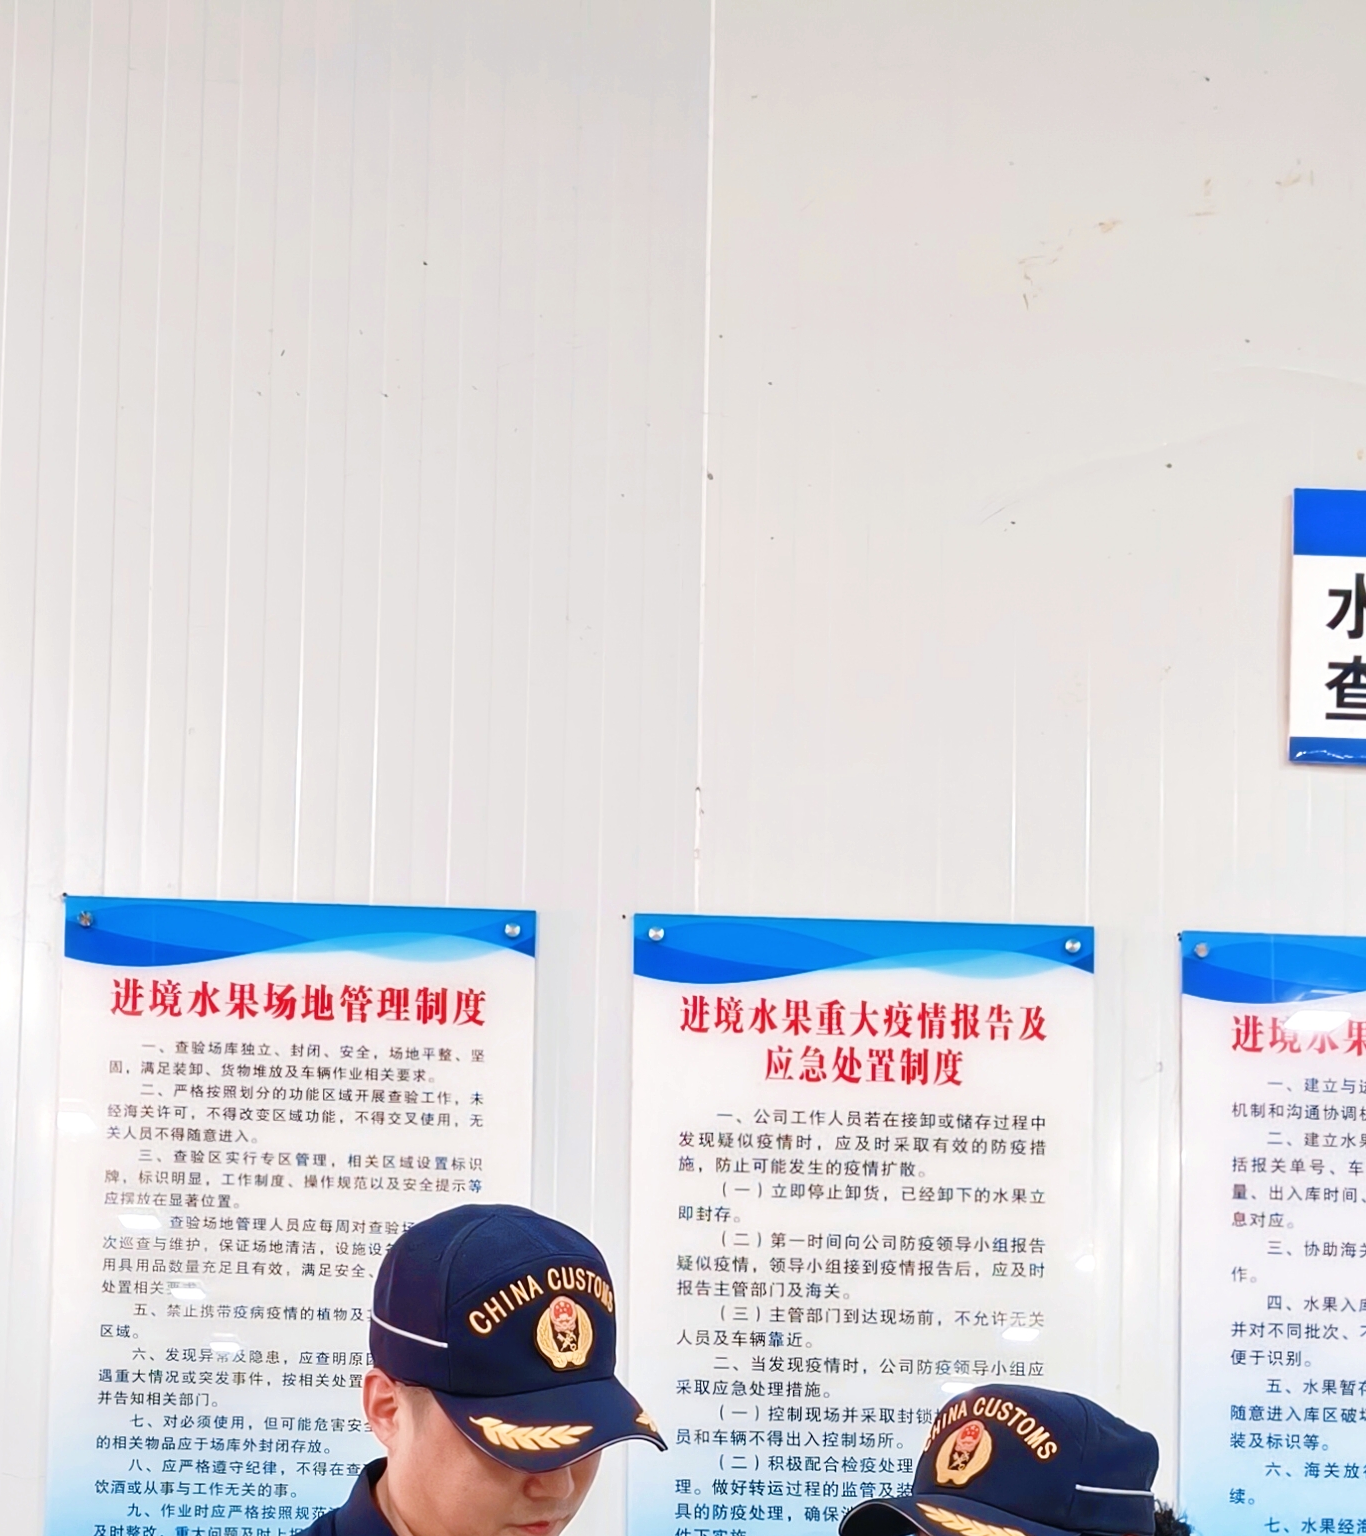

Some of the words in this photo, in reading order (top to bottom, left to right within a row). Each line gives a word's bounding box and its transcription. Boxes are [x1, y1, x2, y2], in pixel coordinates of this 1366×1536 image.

[110, 979, 486, 1025] 进境水果场地管理制度
[680, 996, 1047, 1041] 进境水果重大疫情报告及
[142, 1040, 484, 1062] 一、查验场库独立、封闭、安全，场地平整、坚
[109, 1060, 434, 1082] 固，满足装卸、货物堆放及车辆作业相关要求。
[765, 1045, 963, 1086] 应急处置制度
[140, 1084, 483, 1106] 二、严格按照划分的功能区域开展查验工作，未
[108, 1104, 483, 1127] 经海关许可，不得改变区域功能，不得交叉使用，无
[717, 1109, 1045, 1131] 一、公司工作人员若在接卸或储存过程中
[107, 1126, 257, 1143] 关人员不得随意进入。
[679, 1131, 1046, 1156] 发现疑似疫情时，应及时采取有效的防疫措
[138, 1149, 482, 1171] 三、查验区实行专区管理，相关区域设置标识
[679, 1156, 925, 1177] 施，防止可能发生的疫情扩散。
[105, 1169, 482, 1193] 牌，标识明显，工作制度、操作规范以及安全提示等
[104, 1191, 239, 1208] 应摆放在显著位置。
[723, 1182, 1045, 1204] （一）立即停止卸货，已经卸下的水果立
[679, 1205, 740, 1223] 即封存。
[1232, 1211, 1293, 1228] 息对应。
[722, 1231, 1046, 1254] （二）第一时间向公司防疫领导小组报告
[677, 1255, 1045, 1278] 疑似疫情，领导小组接到疫情报告后，应及时
[1231, 1267, 1256, 1283] 作。
[677, 1279, 849, 1299] 报告主管部门及海关。
[468, 1275, 544, 1335] CHINA
[547, 1267, 614, 1313] CUSTOMS
[721, 1305, 1044, 1327] （三）主管部门到达现场前，不允许无关
[100, 1324, 138, 1339] 区域。
[677, 1329, 812, 1348] 人员及车辆靠近。
[713, 1356, 1044, 1376] 二、当发现疫情时，公司防疫领导小组应
[1230, 1349, 1311, 1367] 便于识别。
[98, 1369, 366, 1390] 遇重大情况或突发事件，按相关处置
[676, 1379, 830, 1398] 采取应急处理措施。
[97, 1390, 218, 1407] 并告知相关部门。
[720, 1404, 937, 1427] （一）控制现场并采取封锁
[973, 1396, 1058, 1460] CUSTOMS
[96, 1435, 330, 1454] 的相关物品应于场库外封闭存放。
[676, 1429, 903, 1449] 员和车辆不得出入控制场所。
[1230, 1432, 1328, 1451] 装及标识等。
[128, 1459, 367, 1480] 八、应严格遵守纪律，不得在查
[94, 1479, 296, 1498] 饮酒或从事与工作无关的事。
[675, 1478, 912, 1502] 理。做好转运过程的监管及装
[1229, 1488, 1255, 1505] 续。
[127, 1502, 336, 1524] 九、作业时应严格按照规范
